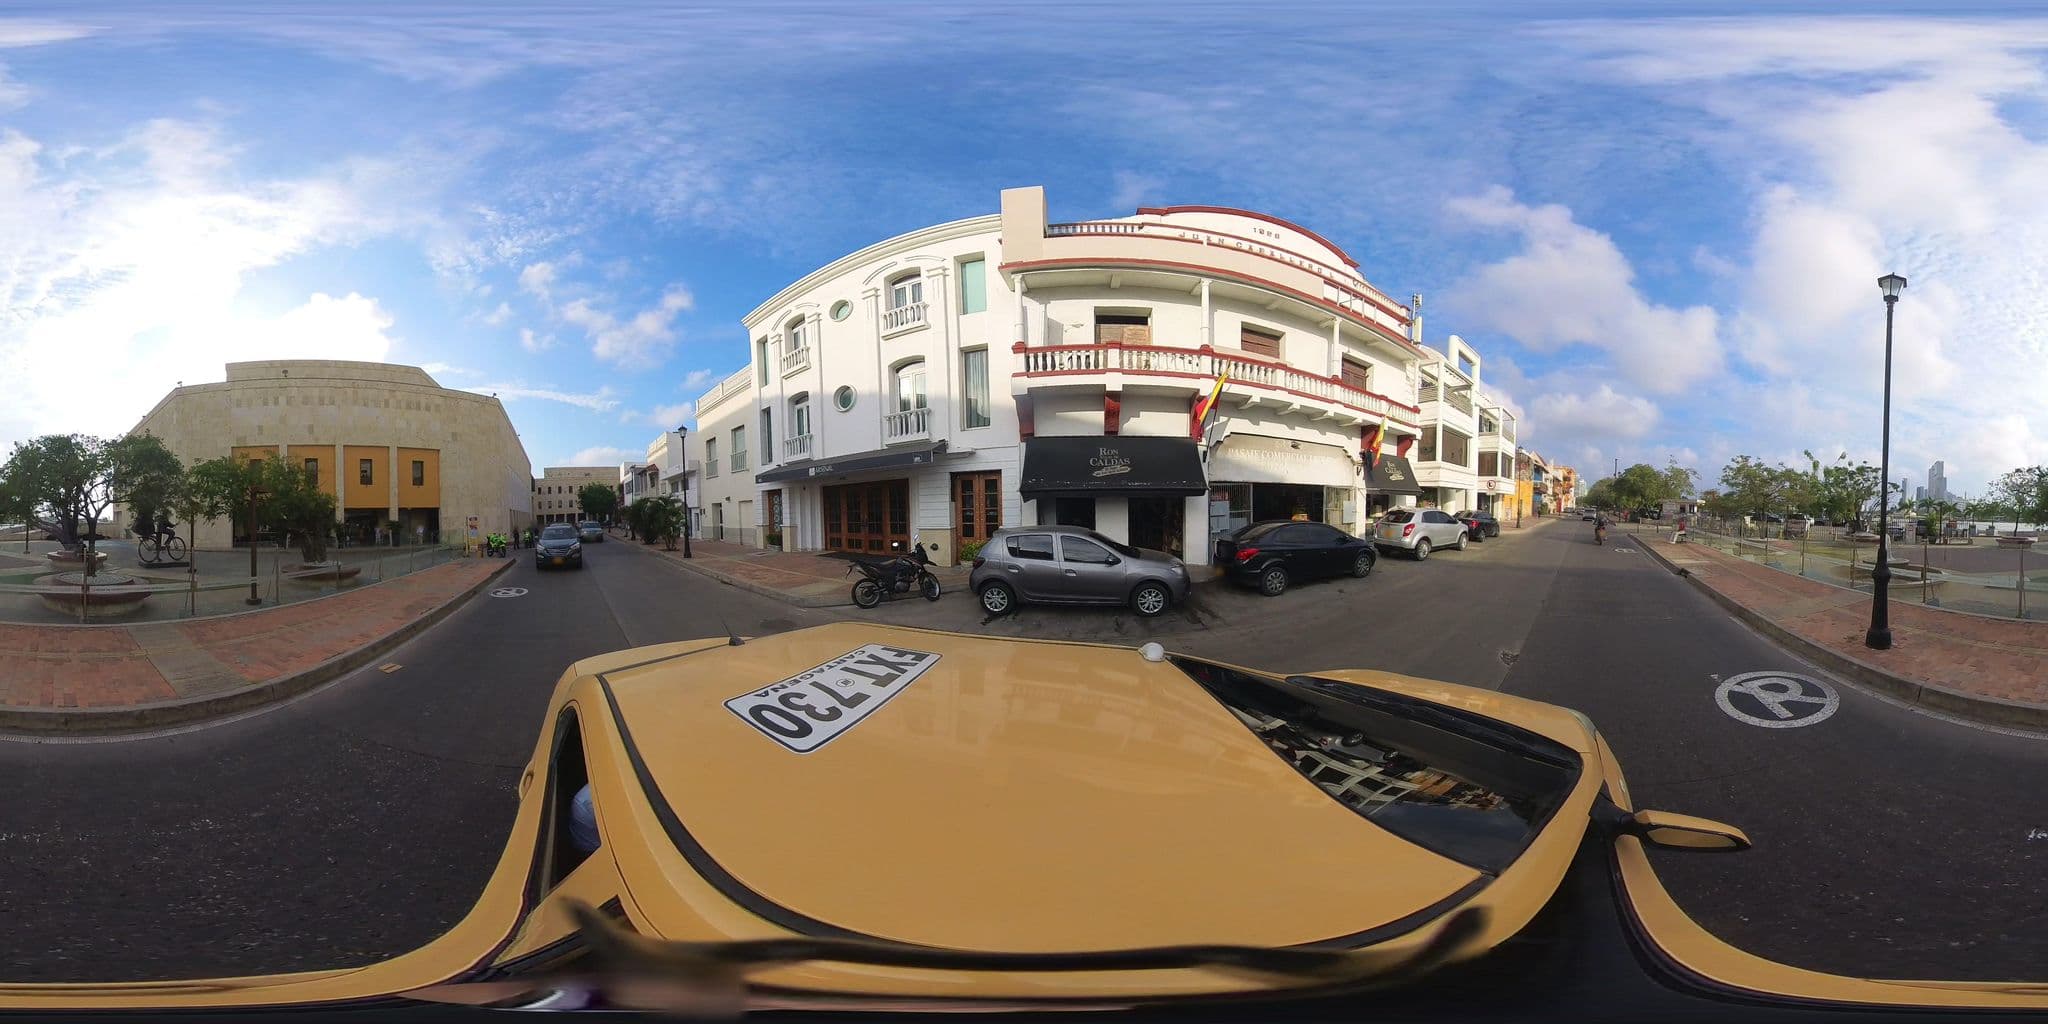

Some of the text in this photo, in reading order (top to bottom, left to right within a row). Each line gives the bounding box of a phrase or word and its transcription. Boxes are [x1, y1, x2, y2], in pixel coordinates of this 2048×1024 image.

[1099, 447, 1119, 456] RON
[1089, 457, 1131, 467] CALDAS
[754, 650, 867, 698] CARTAGENA
